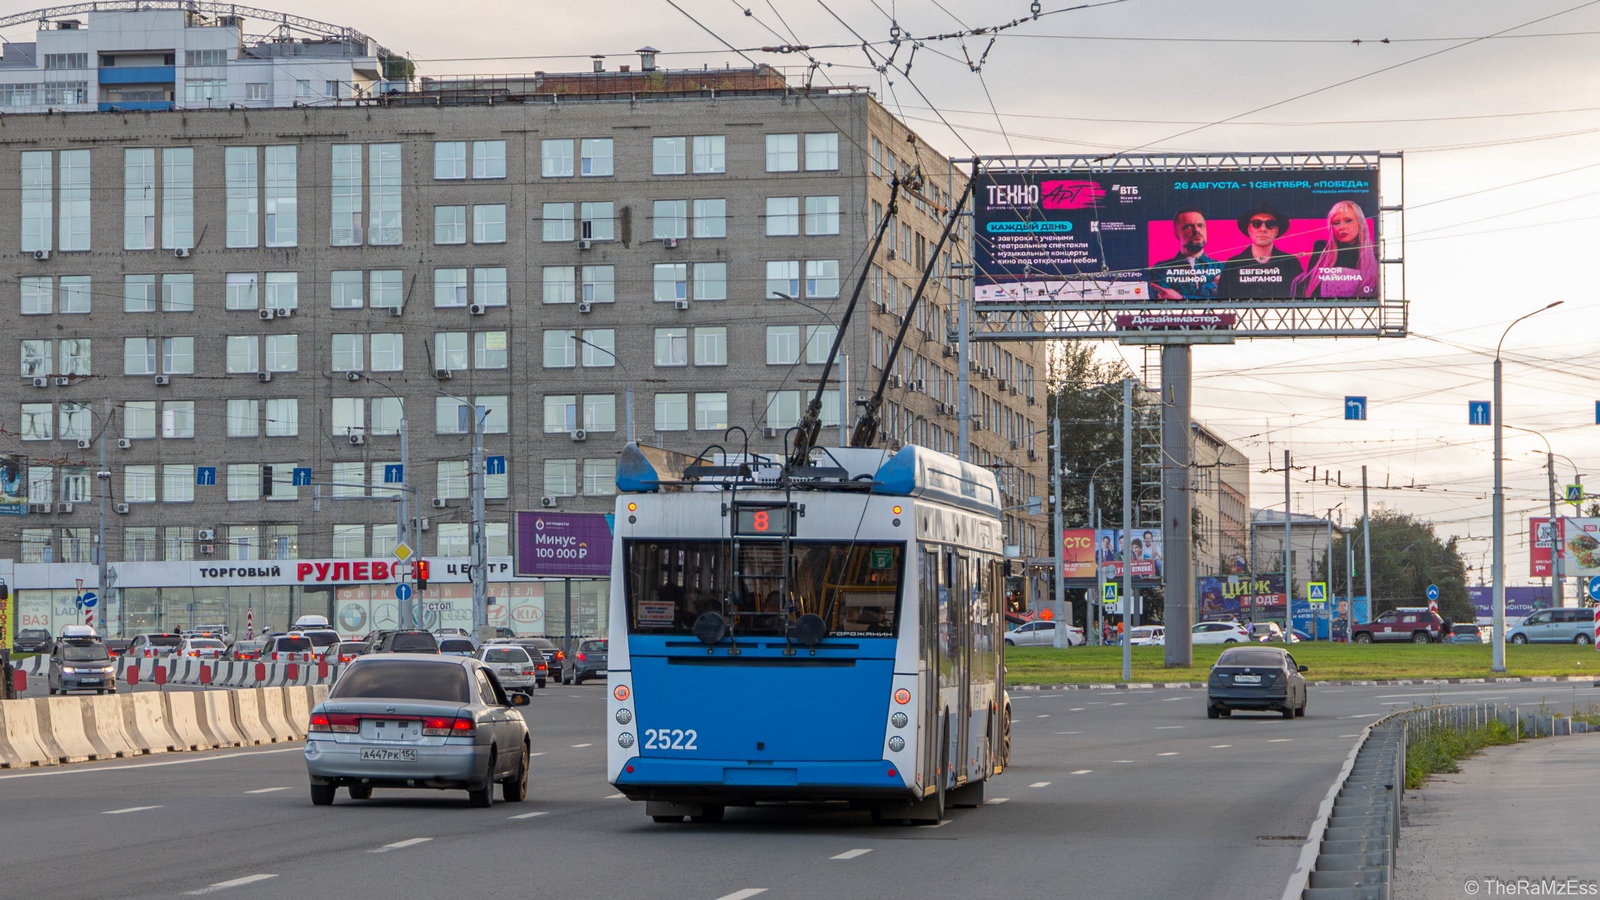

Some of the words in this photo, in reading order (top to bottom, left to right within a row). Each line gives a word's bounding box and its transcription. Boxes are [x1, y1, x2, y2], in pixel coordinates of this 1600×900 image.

[1120, 186, 1139, 195] ВТБ
[1174, 182, 1189, 190] 26
[1190, 181, 1240, 190] АВГУСТА
[986, 184, 1039, 205] ТЕХНО
[991, 222, 1039, 232] КАЖДЫЙ
[1040, 224, 1068, 232] ДЕНЬ
[997, 250, 1050, 258] музыкальные
[1051, 250, 1088, 258] концерты
[1166, 268, 1221, 276] АЛЕКСАНДР
[1239, 267, 1280, 275] ЕВГЕНИЙ
[1166, 275, 1207, 283] ПУШНОЙ
[1239, 275, 1283, 283] ЦЫГАНОВ
[1318, 273, 1363, 281] ЧАЙКИНА
[1131, 314, 1221, 326] Дизайнмастер.
[753, 511, 769, 531] 8
[535, 533, 576, 548] Минус
[1063, 537, 1091, 548] СТС
[536, 548, 554, 558] 100
[556, 548, 577, 559] 000
[199, 565, 281, 578] ТОРГОВЫЙ
[447, 563, 508, 575] ЦЕТР
[343, 588, 452, 598] ФИРМЫЙ
[489, 587, 533, 597] ТДЕЛ
[1221, 580, 1272, 599] ЦИРК
[428, 602, 452, 610] СТОП
[517, 609, 539, 619] KIA
[22, 614, 49, 626] ВАЗ
[644, 729, 698, 751] 2522
